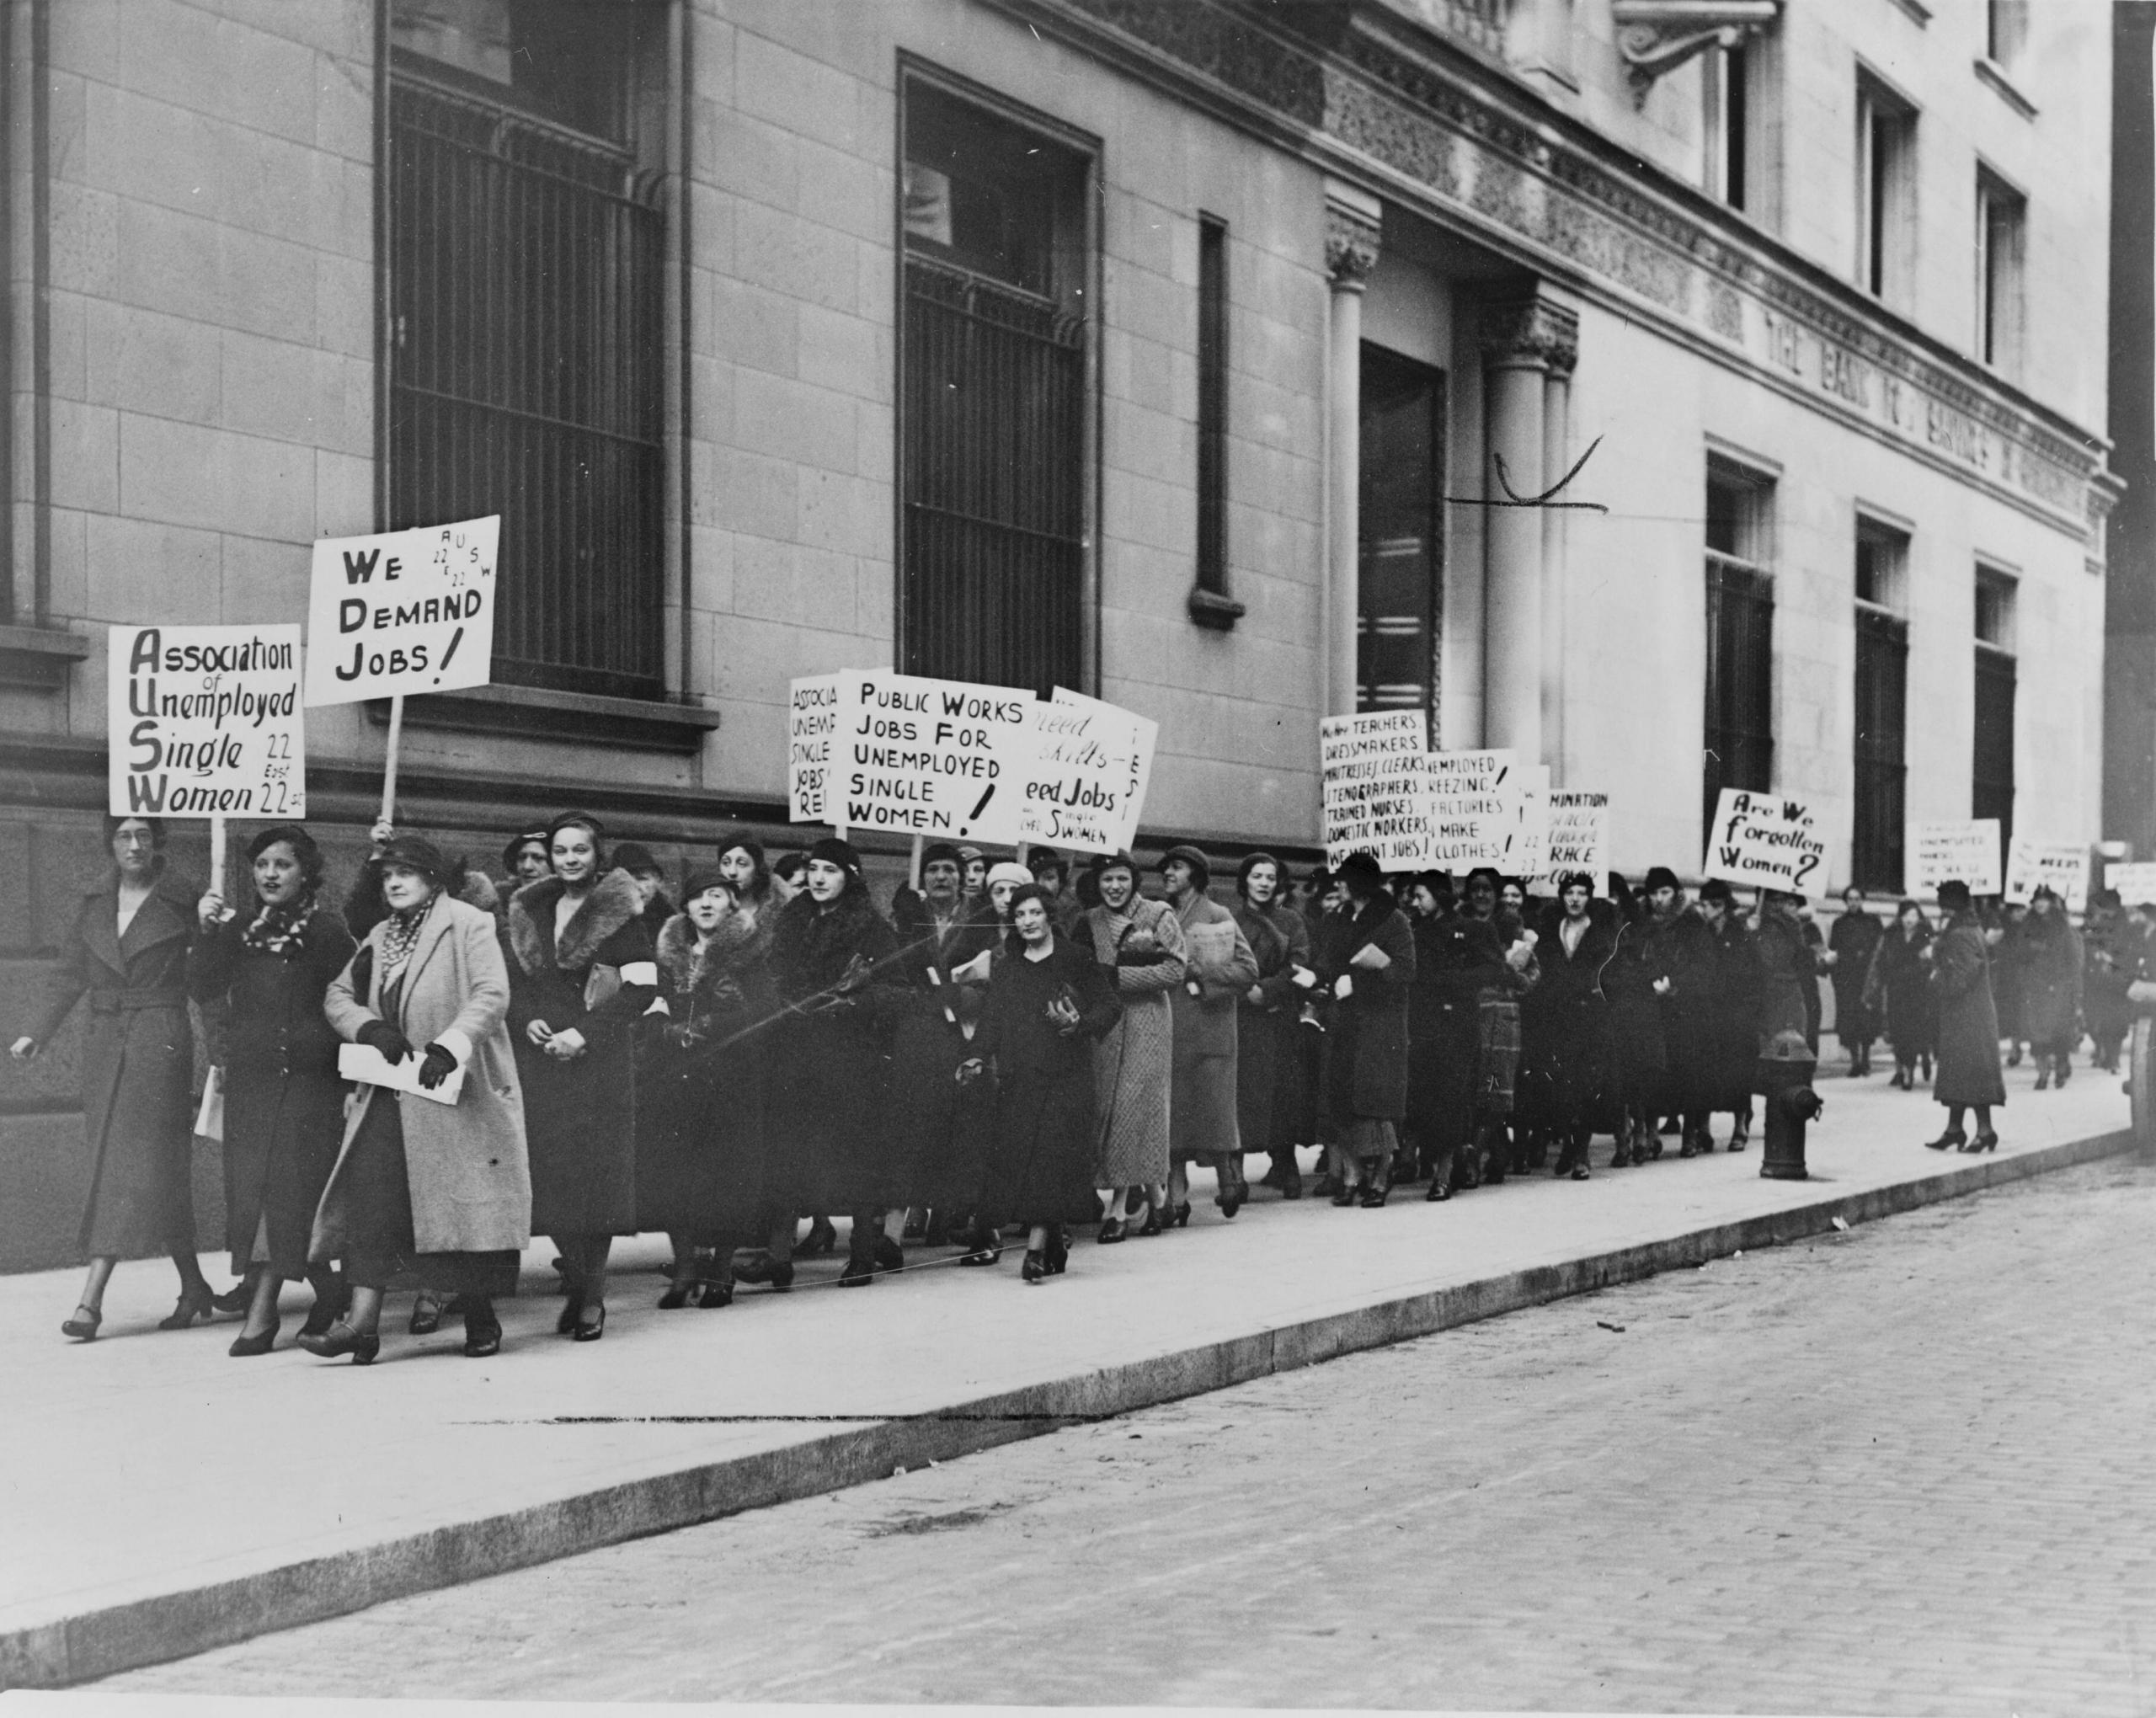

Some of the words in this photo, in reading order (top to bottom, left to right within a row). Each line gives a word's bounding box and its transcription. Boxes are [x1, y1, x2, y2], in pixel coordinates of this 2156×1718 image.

[339, 589, 482, 634] DEMAND
[129, 627, 293, 675] Association
[202, 674, 222, 691] of
[129, 676, 296, 729] Unemployed
[861, 682, 930, 714] PUBLIC
[942, 691, 1023, 724] WORKS
[129, 719, 243, 777] Single
[856, 714, 918, 741] JOBS
[935, 722, 993, 750] FOR
[791, 741, 830, 765] SINGLE
[854, 744, 1001, 779] UNEMPLOYED
[127, 773, 253, 814] Women
[850, 773, 934, 802] SINGLE
[1064, 777, 1116, 812] Jobs
[1732, 793, 1774, 817] Are
[1783, 801, 1814, 828] We
[1439, 821, 1480, 838] MAKE
[1550, 846, 1598, 863] RACE
